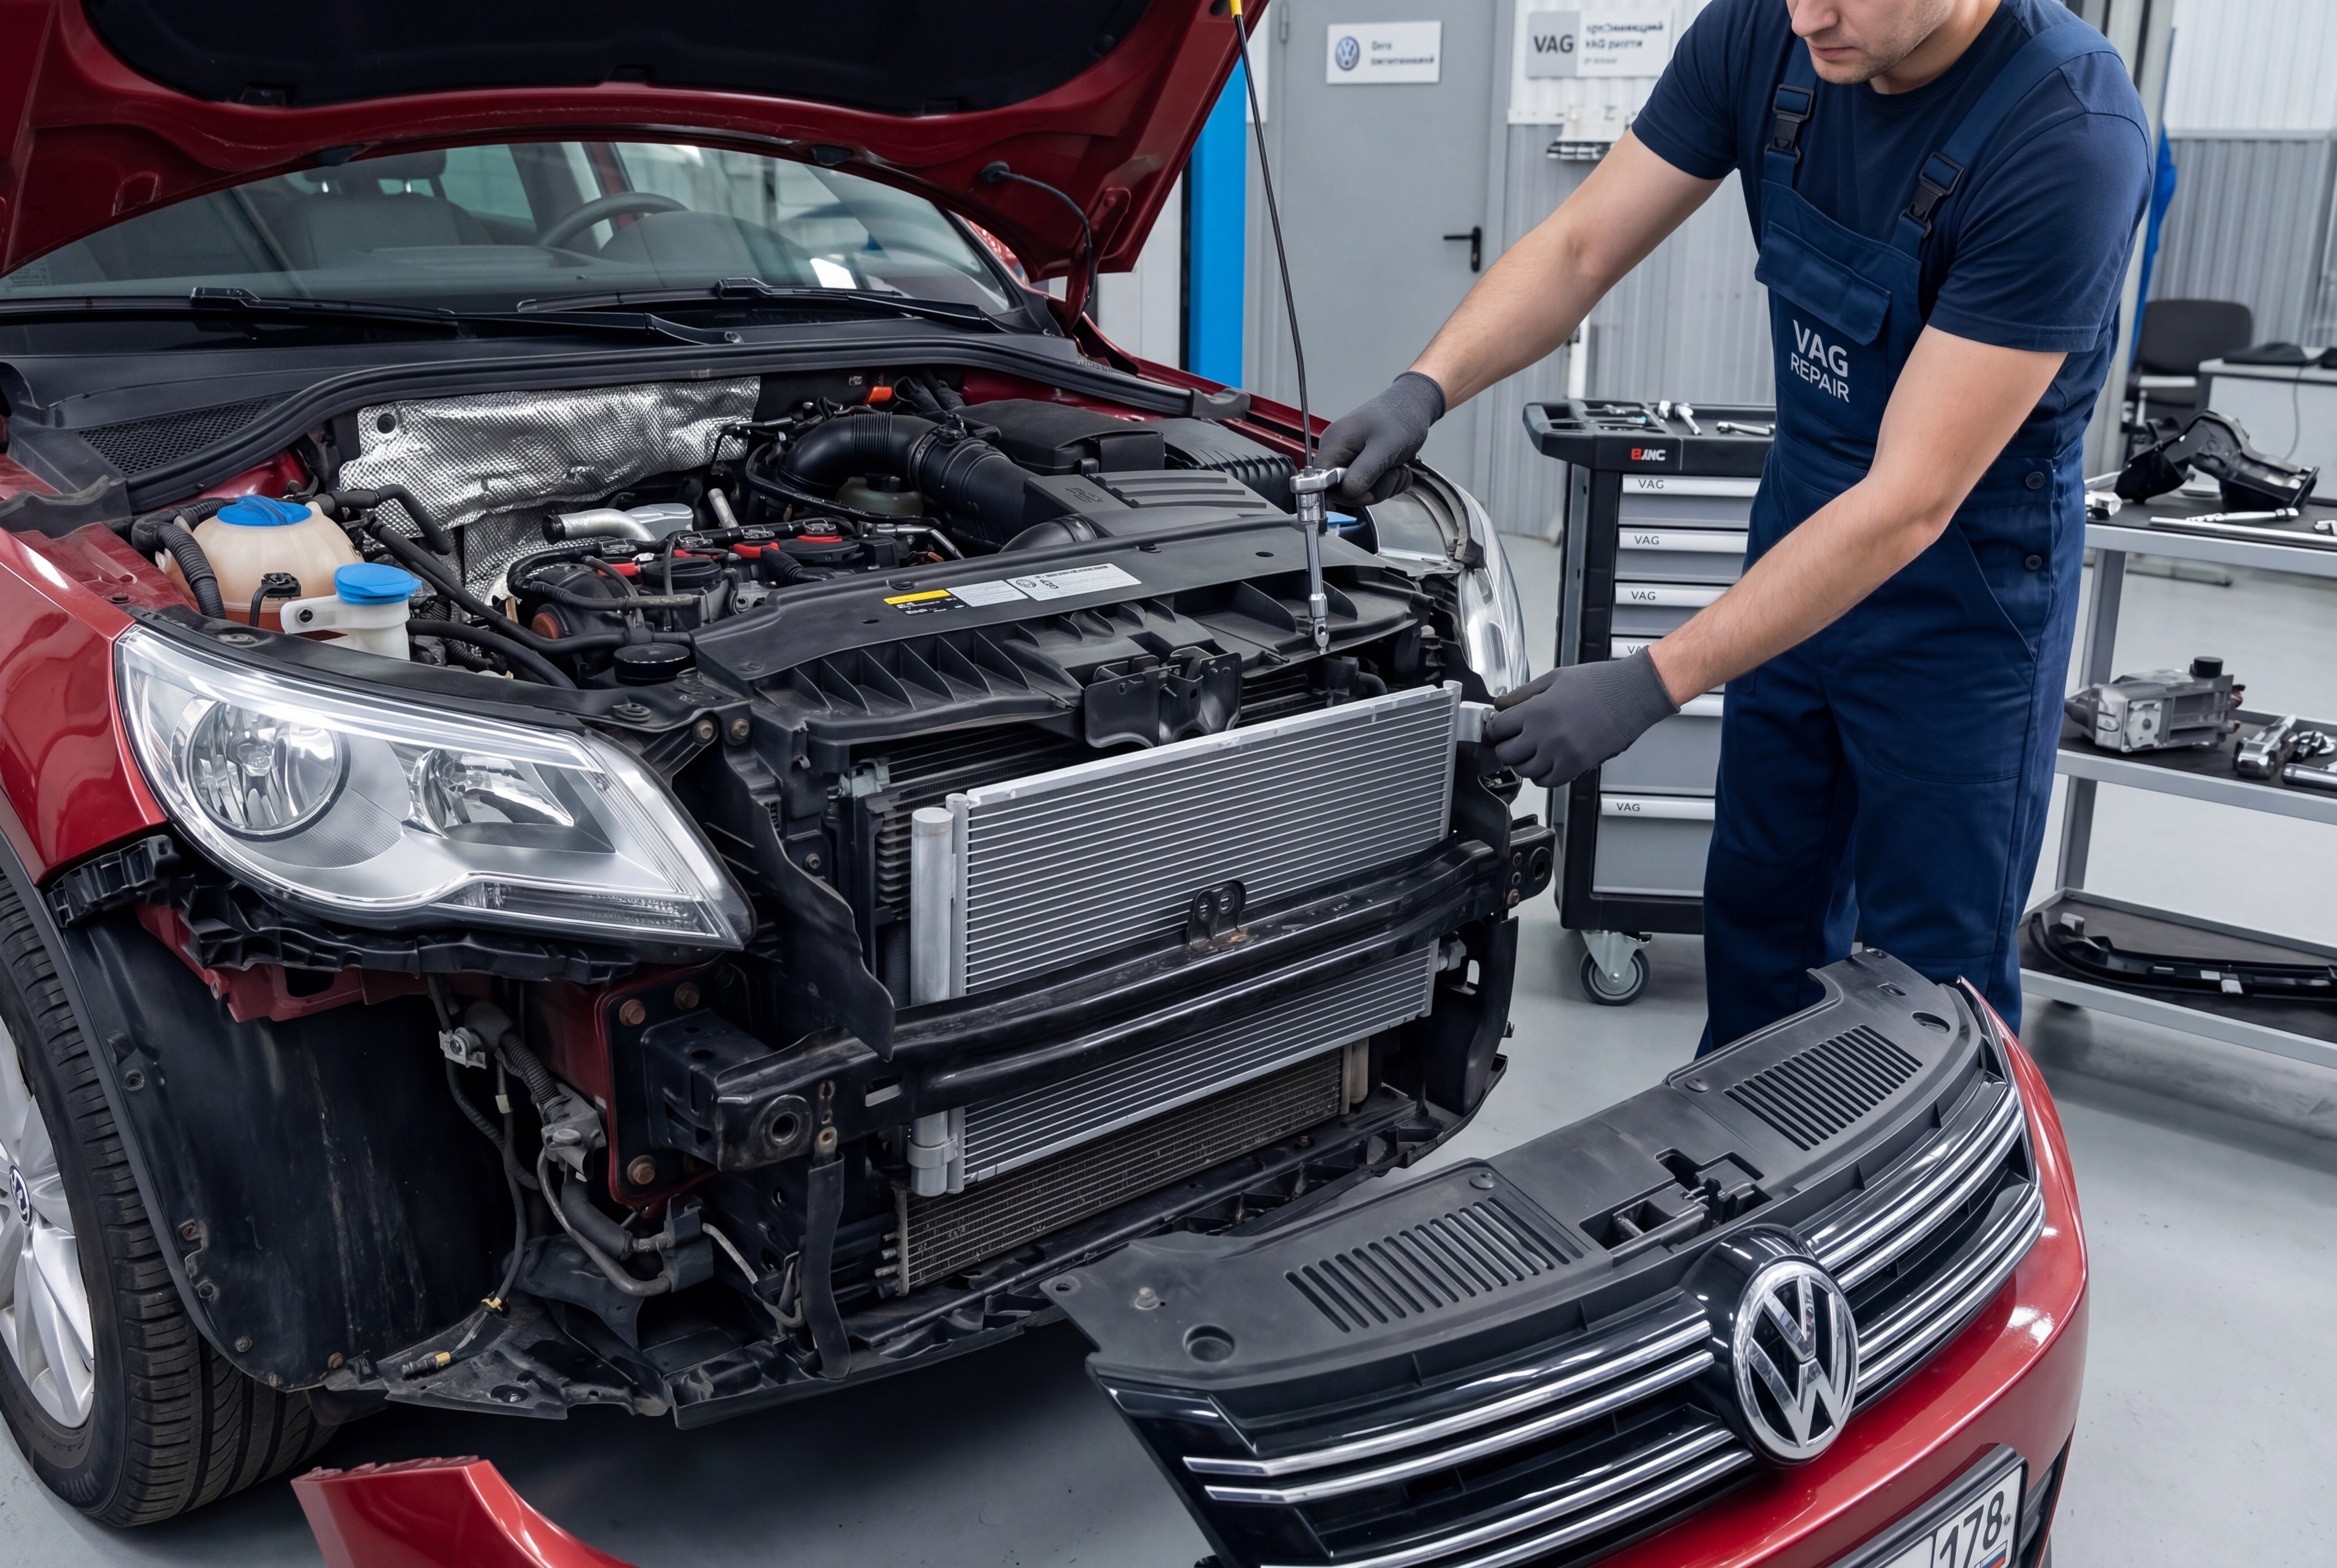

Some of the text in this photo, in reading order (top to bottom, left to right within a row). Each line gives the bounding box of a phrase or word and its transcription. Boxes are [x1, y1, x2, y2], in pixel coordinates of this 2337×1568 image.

[1534, 35, 1574, 53] VAG
[1793, 319, 1848, 377] VAG
[1791, 352, 1849, 403] REPAIR
[1638, 479, 1664, 489] VAG
[1634, 535, 1659, 545] VAG
[1631, 591, 1656, 601] VAG
[1617, 803, 1640, 812] VAG
[1939, 1490, 2004, 1568] 178
